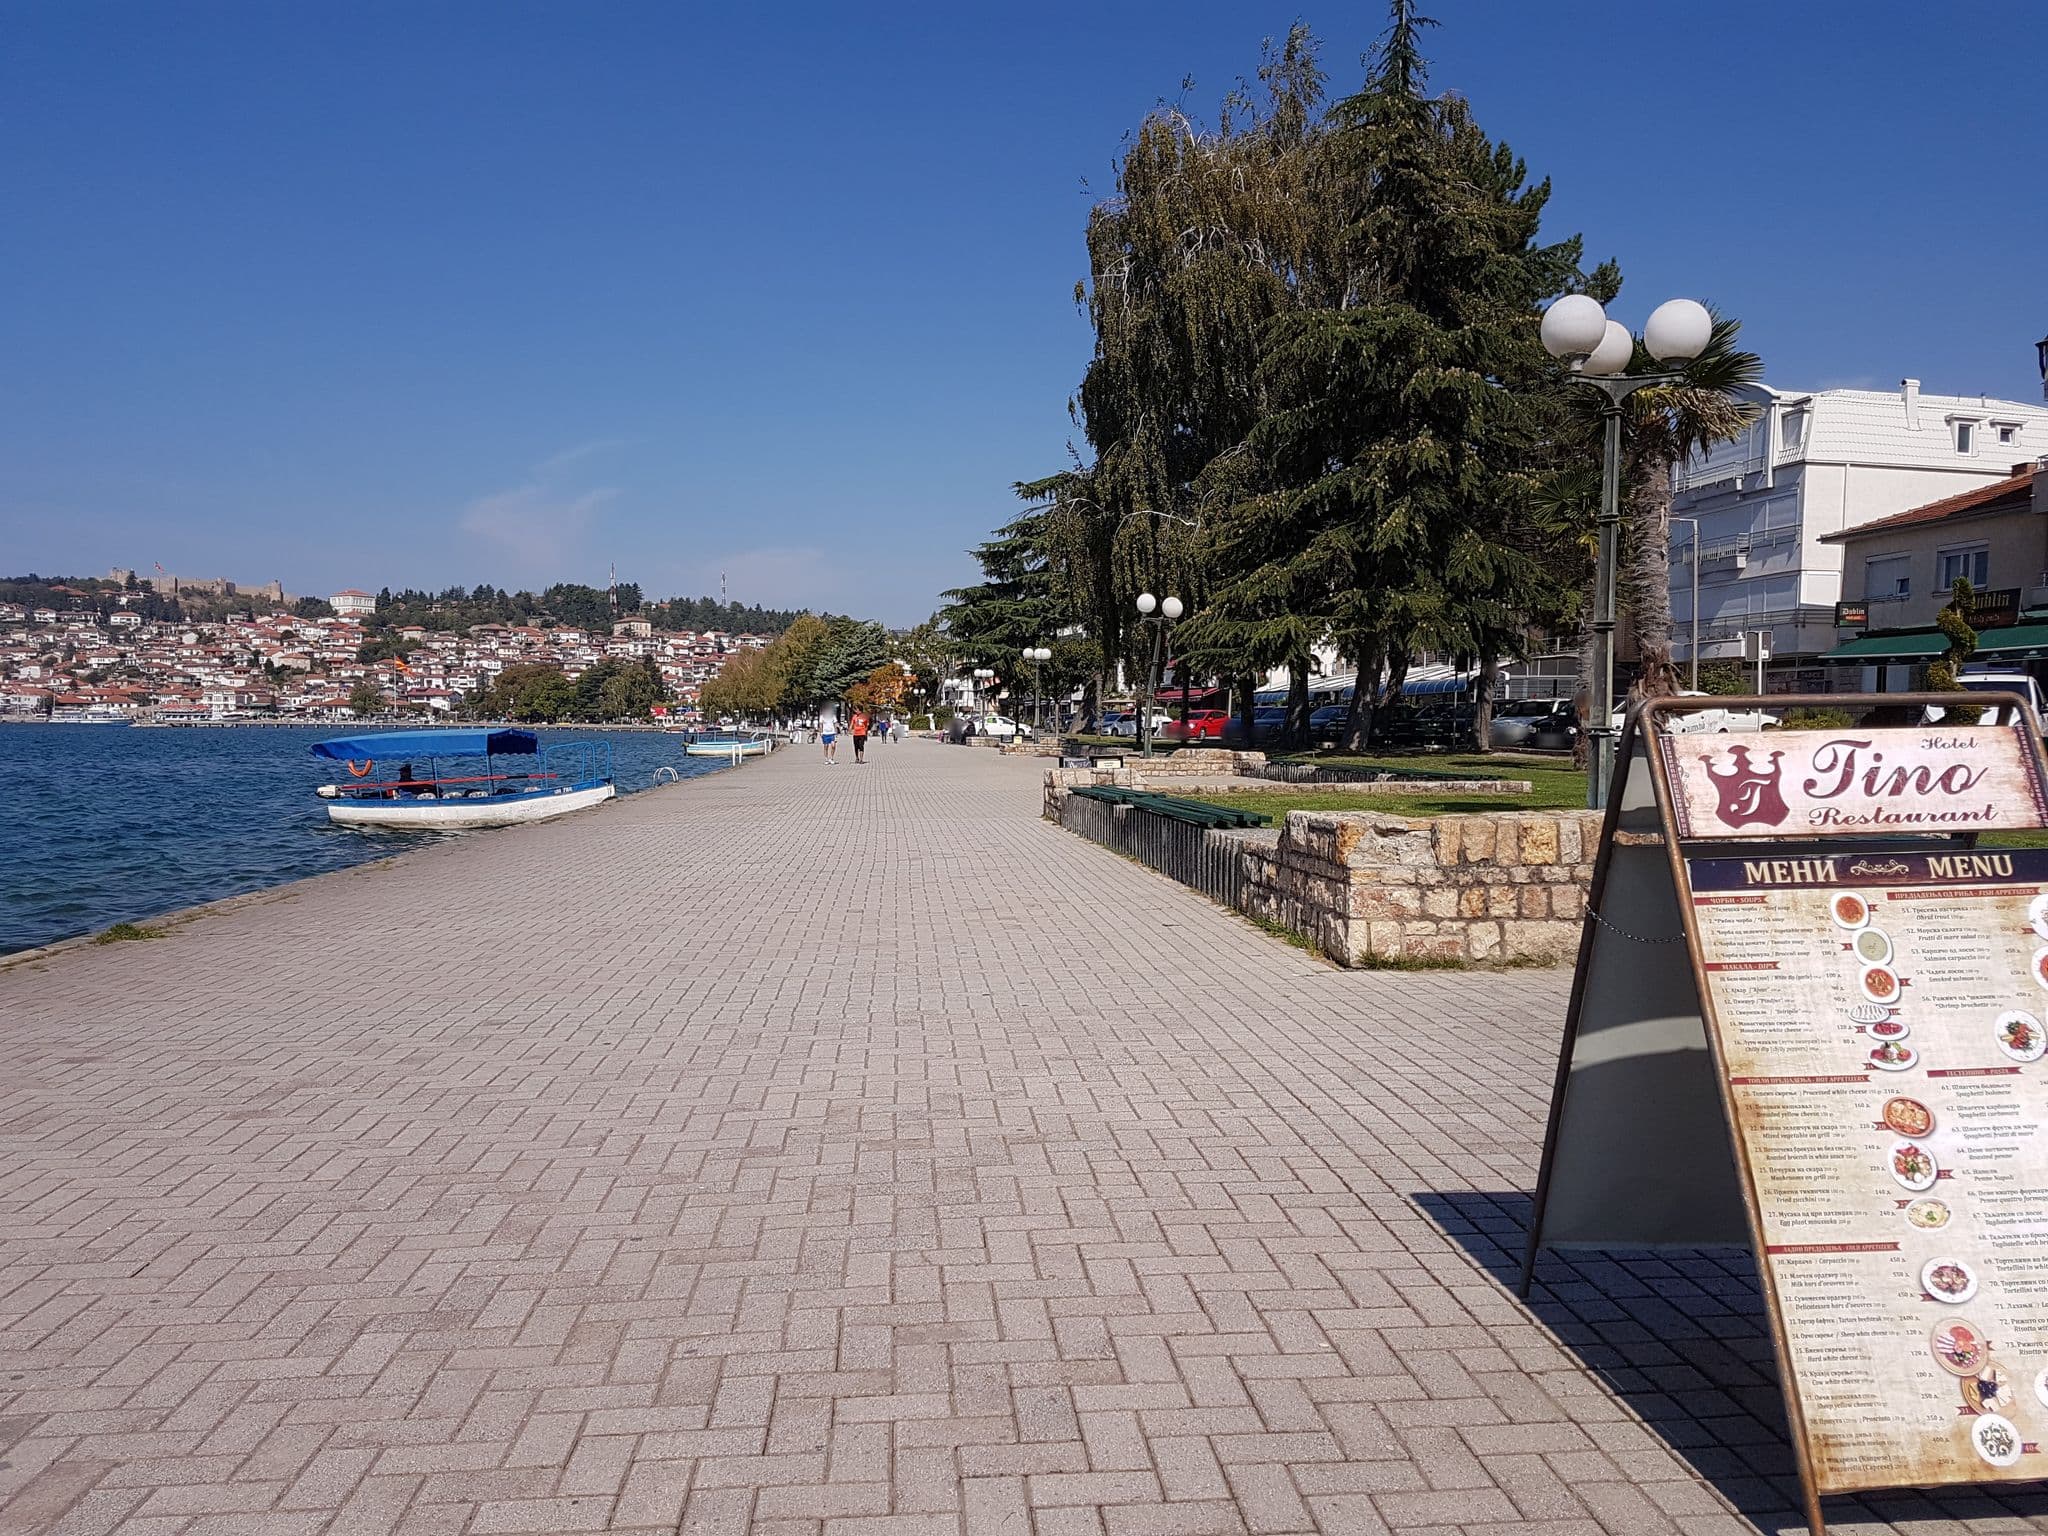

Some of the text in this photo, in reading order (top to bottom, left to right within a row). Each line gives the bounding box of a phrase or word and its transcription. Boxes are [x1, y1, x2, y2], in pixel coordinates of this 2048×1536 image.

[1842, 607, 1865, 615] Dublin
[1975, 593, 2009, 609] ublin
[1921, 737, 1979, 751] Hotel
[1803, 740, 1988, 799] Tino
[1808, 803, 2000, 827] Restaurant
[1744, 859, 1838, 885] МЕНИ
[1928, 855, 2013, 879] MENU
